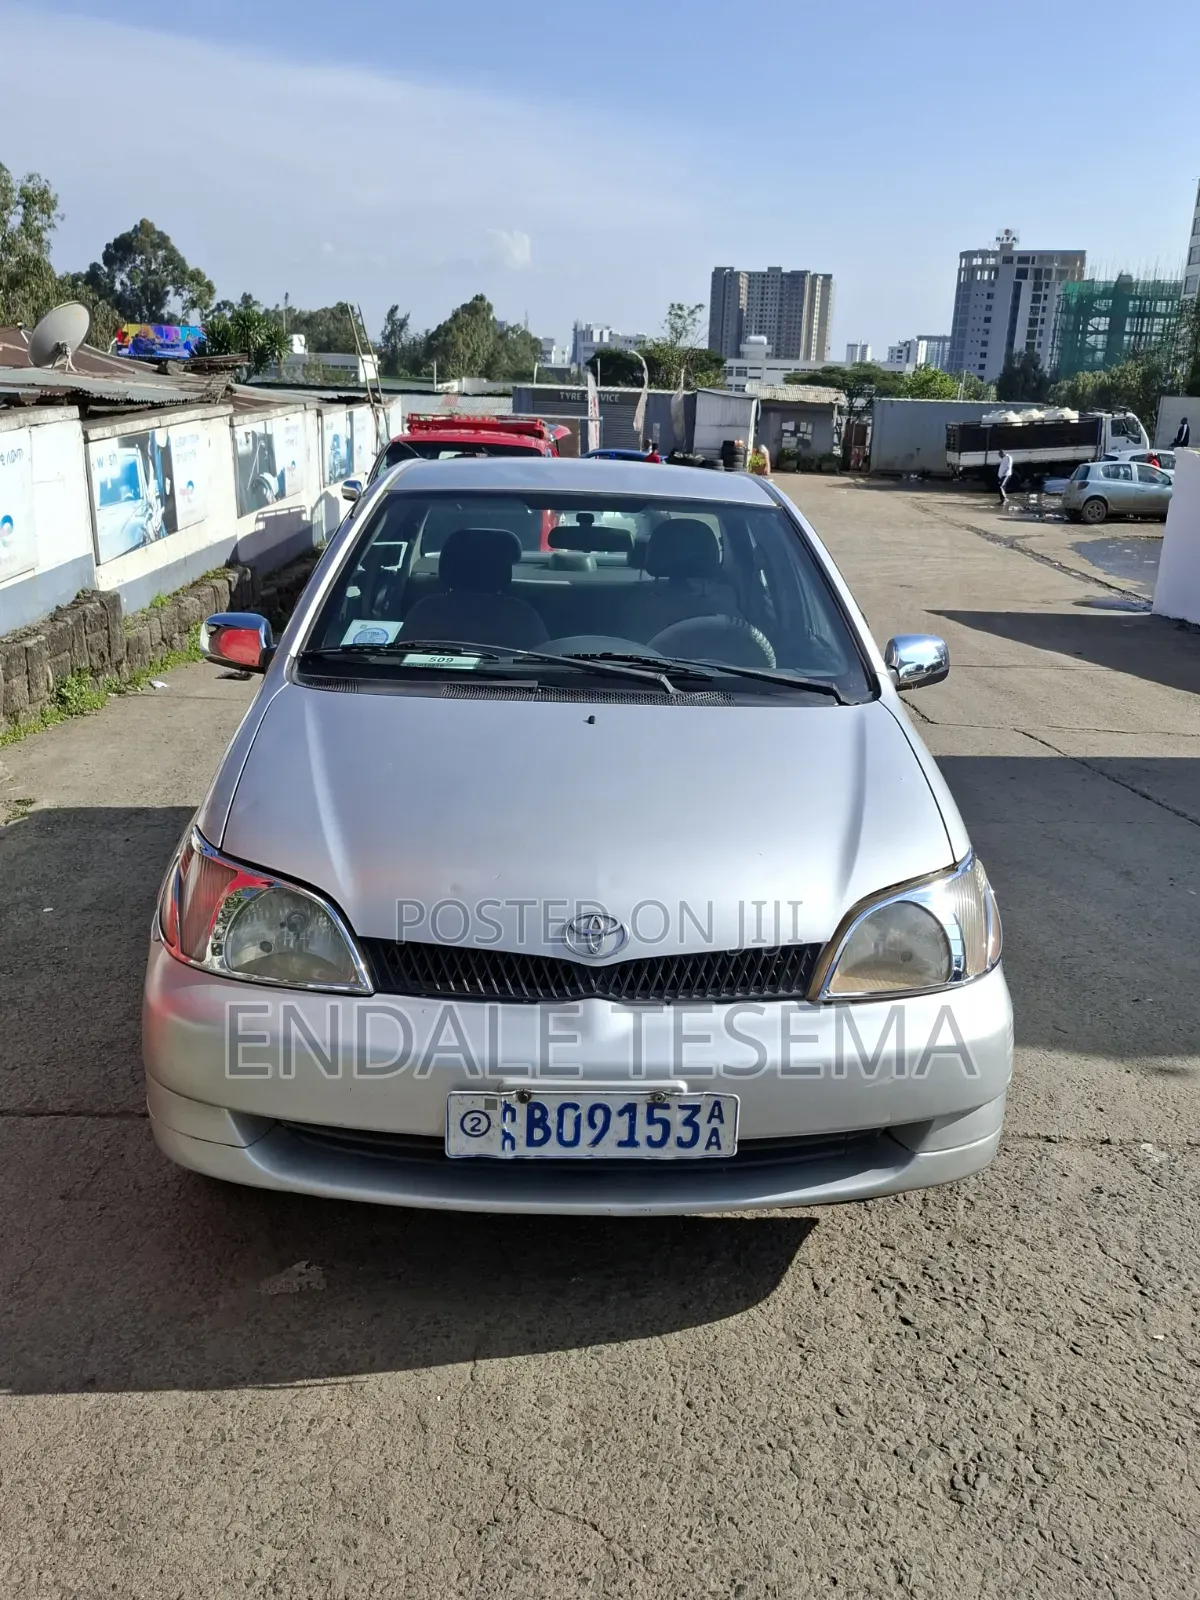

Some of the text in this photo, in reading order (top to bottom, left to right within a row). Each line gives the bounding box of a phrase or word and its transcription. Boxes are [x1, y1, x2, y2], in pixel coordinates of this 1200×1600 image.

[559, 391, 620, 403] TYRE SVICE
[526, 1101, 702, 1149] B09153
